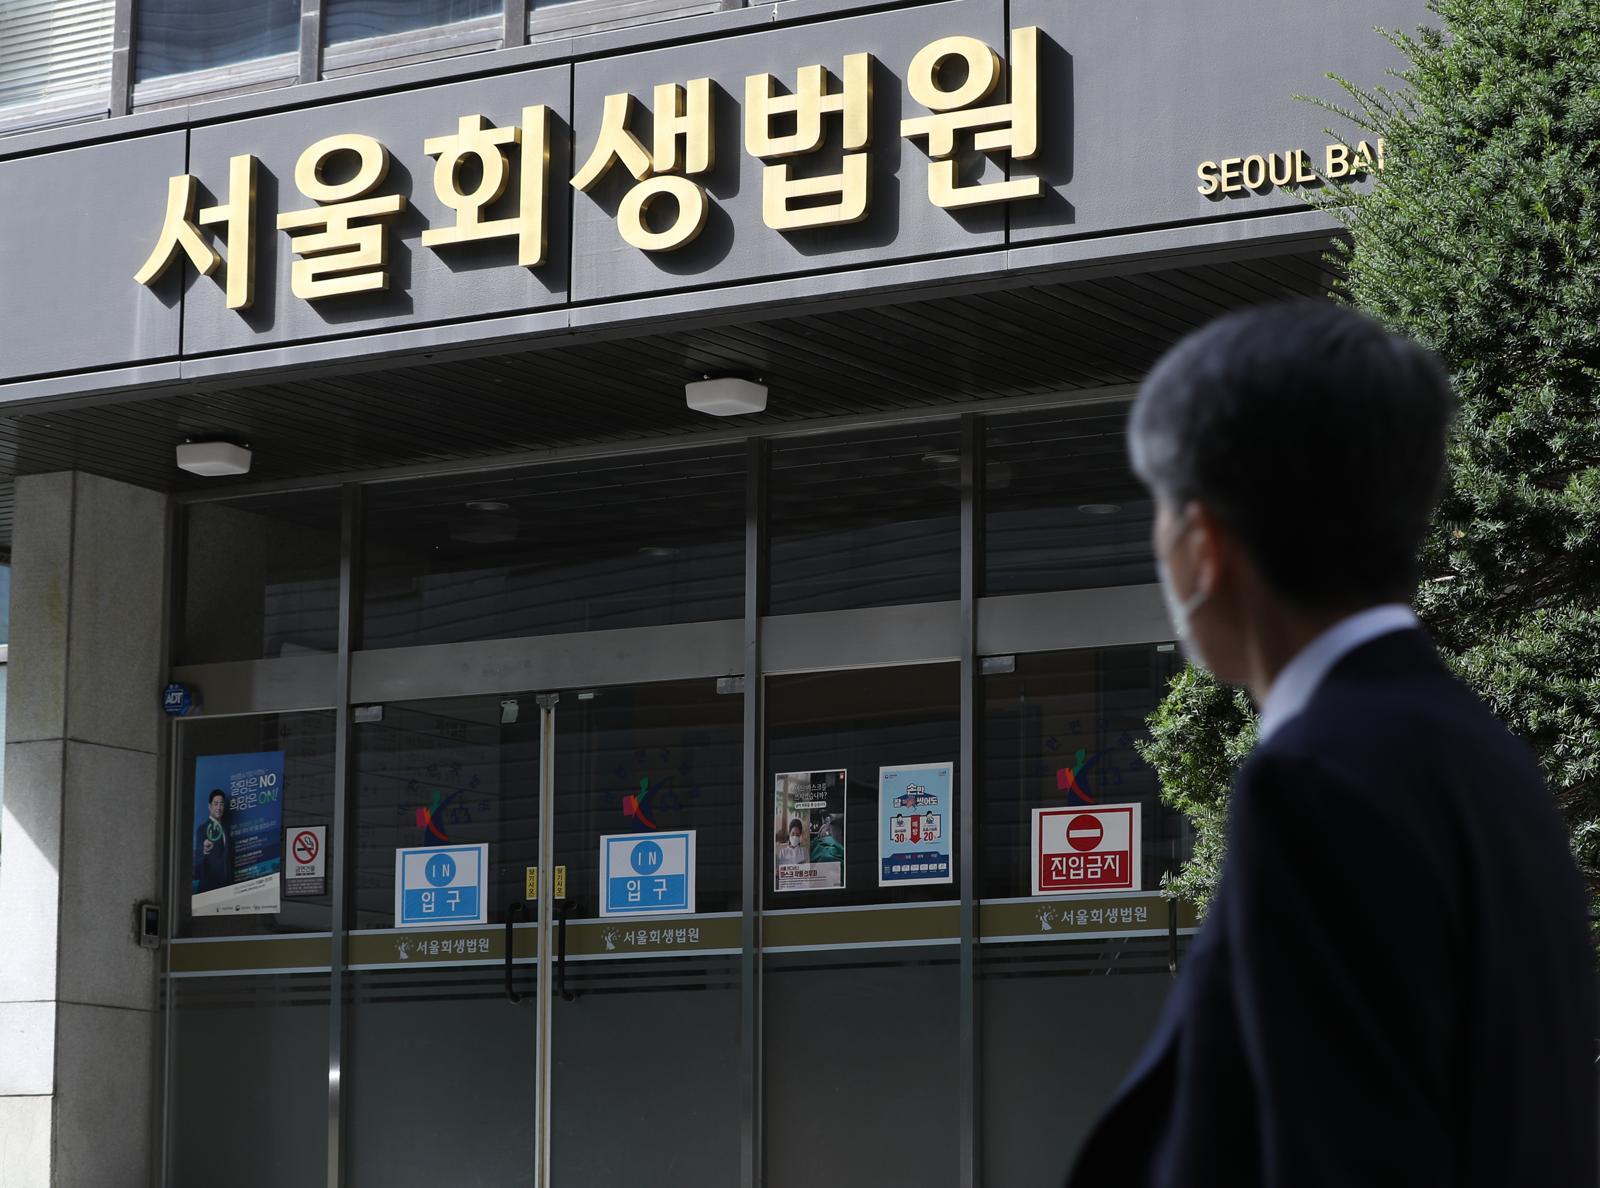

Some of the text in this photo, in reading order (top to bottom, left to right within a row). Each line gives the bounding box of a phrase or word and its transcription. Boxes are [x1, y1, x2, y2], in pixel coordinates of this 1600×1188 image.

[134, 26, 1044, 310] 서울회생법원
[1197, 148, 1316, 196] SEOUL
[165, 692, 184, 705] ADT
[259, 773, 277, 788] NO
[906, 783, 925, 795] 손만
[638, 851, 657, 866] IN
[432, 863, 450, 878] IN
[1050, 854, 1120, 881] 진입금지
[1061, 906, 1147, 925] 서울회생법원
[623, 927, 700, 945] 서울회생법원
[416, 938, 489, 955] 서울회생법원
